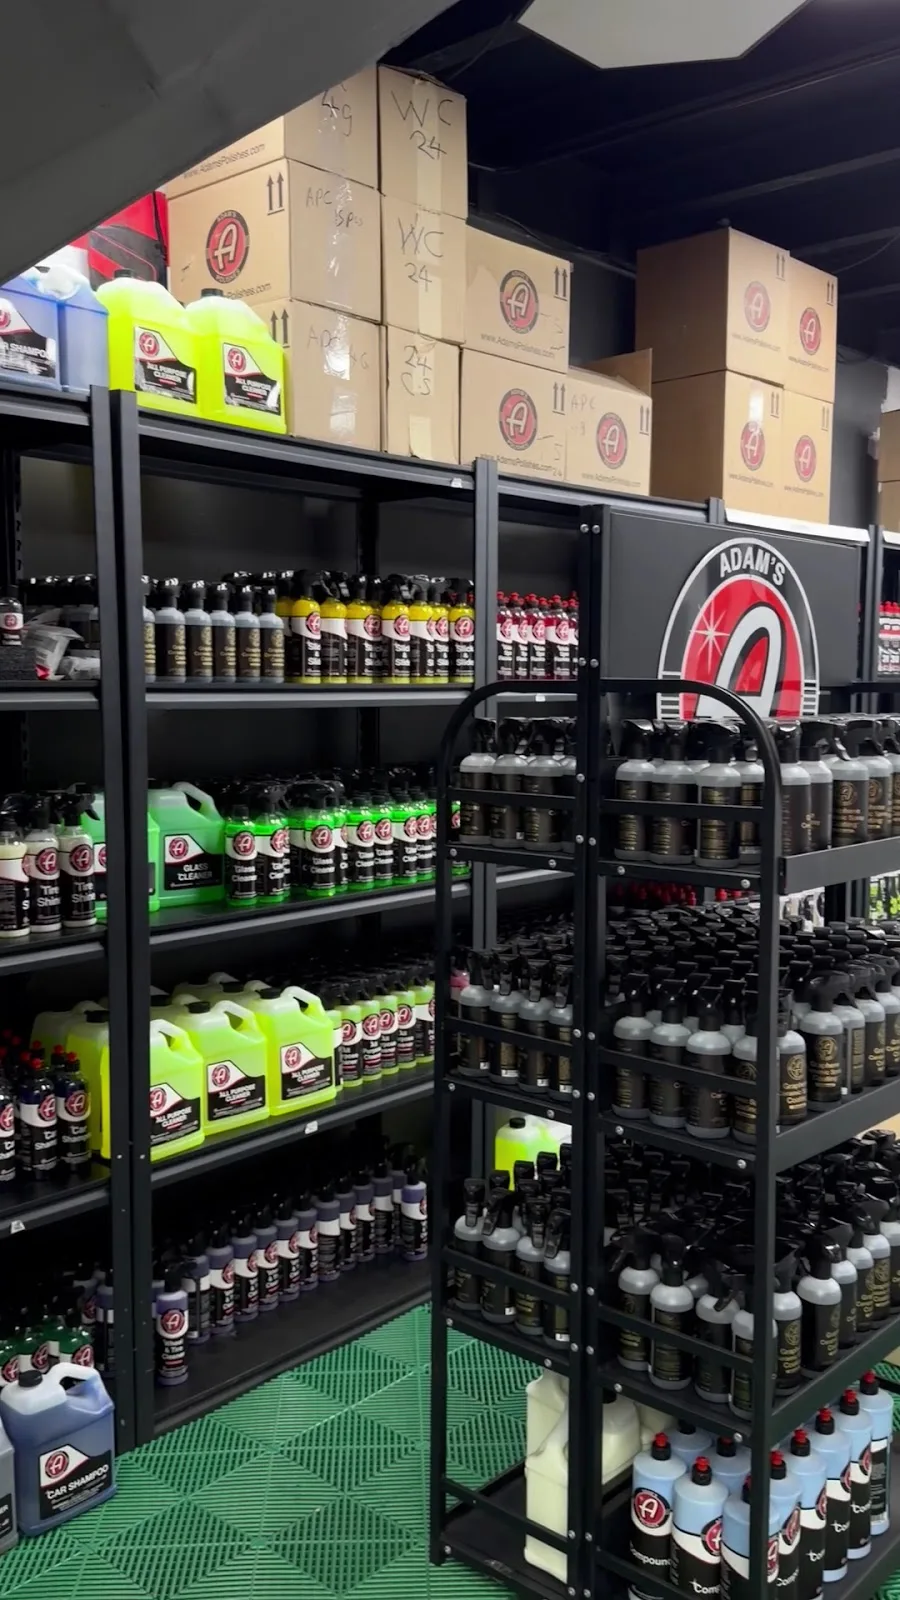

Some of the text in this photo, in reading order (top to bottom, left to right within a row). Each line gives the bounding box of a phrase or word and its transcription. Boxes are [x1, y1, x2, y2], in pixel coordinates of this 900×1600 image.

[410, 131, 447, 159] 24
[404, 262, 432, 292] 24
[404, 345, 432, 376] 24
[719, 546, 786, 586] ADAM'S
[177, 871, 212, 881] CLEANER
[183, 863, 208, 872] GLASS
[46, 1485, 67, 1499] CAR
[68, 1464, 109, 1491] SHAMPOO
